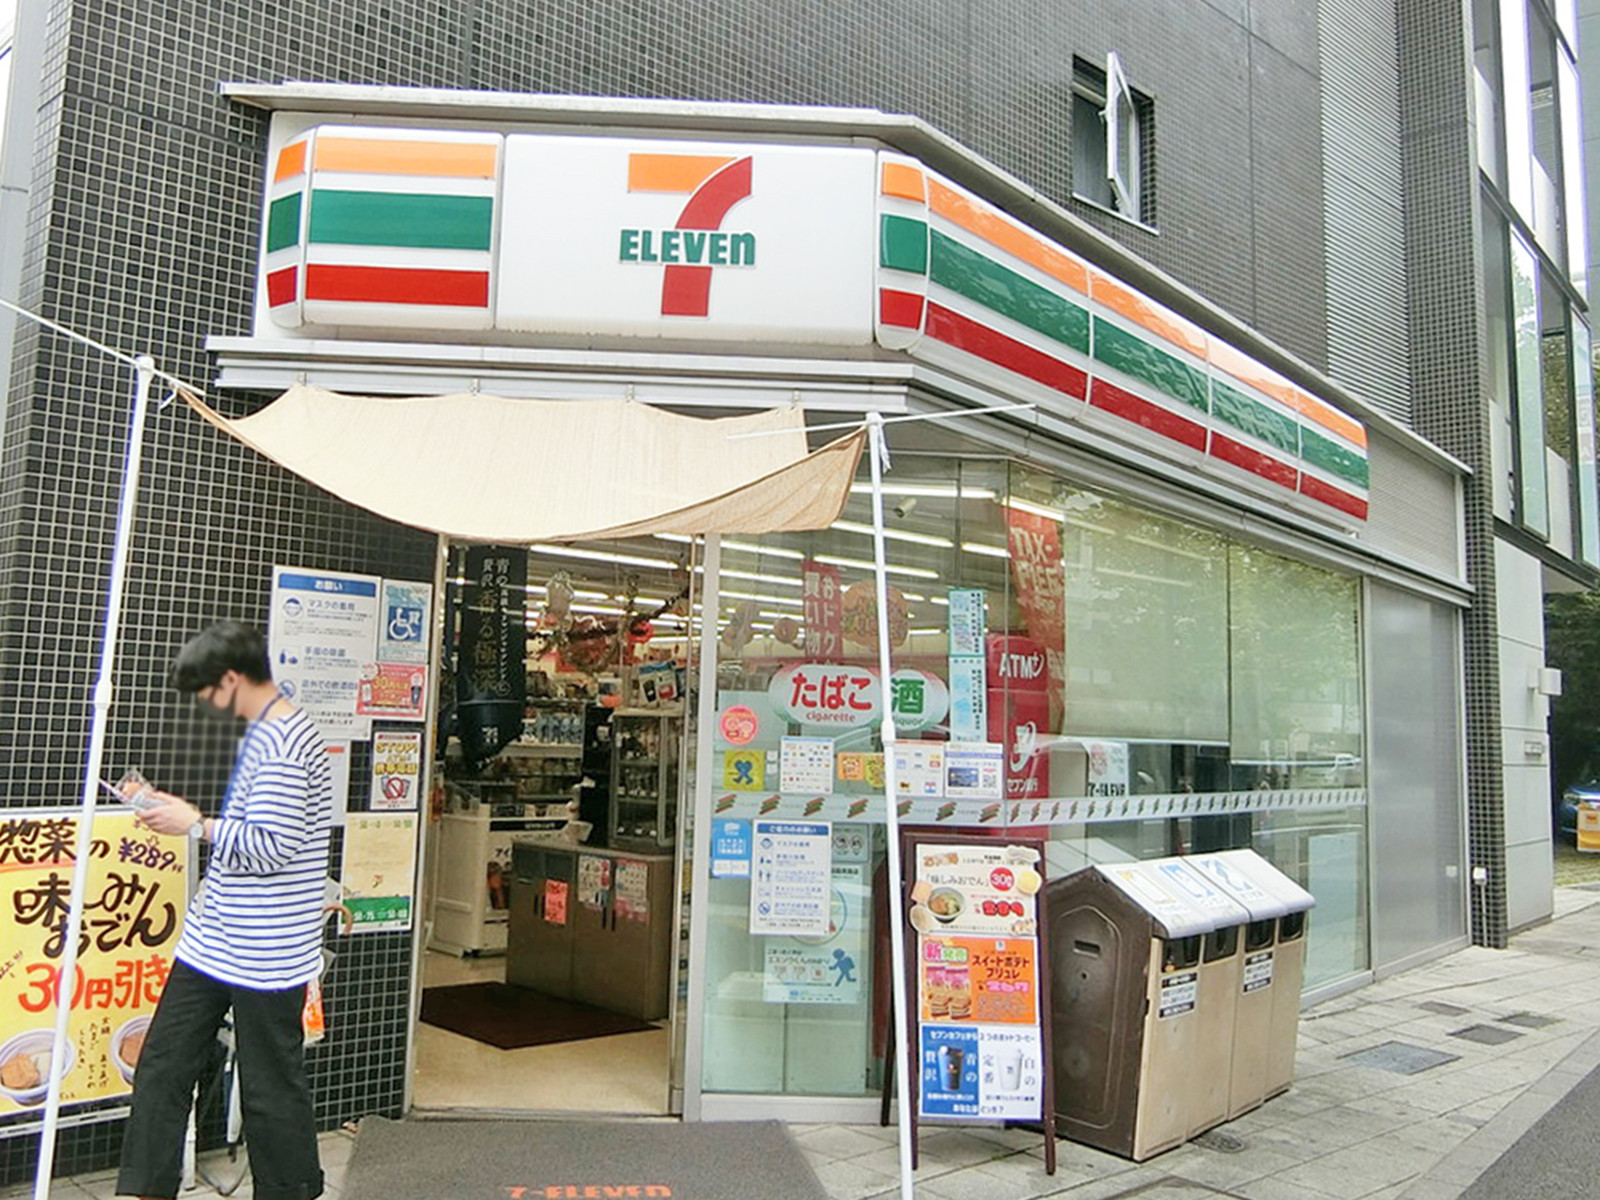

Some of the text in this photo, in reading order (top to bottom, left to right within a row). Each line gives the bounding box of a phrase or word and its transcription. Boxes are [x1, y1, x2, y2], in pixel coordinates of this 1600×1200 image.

[791, 672, 872, 710] たばこ
[890, 677, 925, 714] 酒
[806, 711, 856, 723] cigarette
